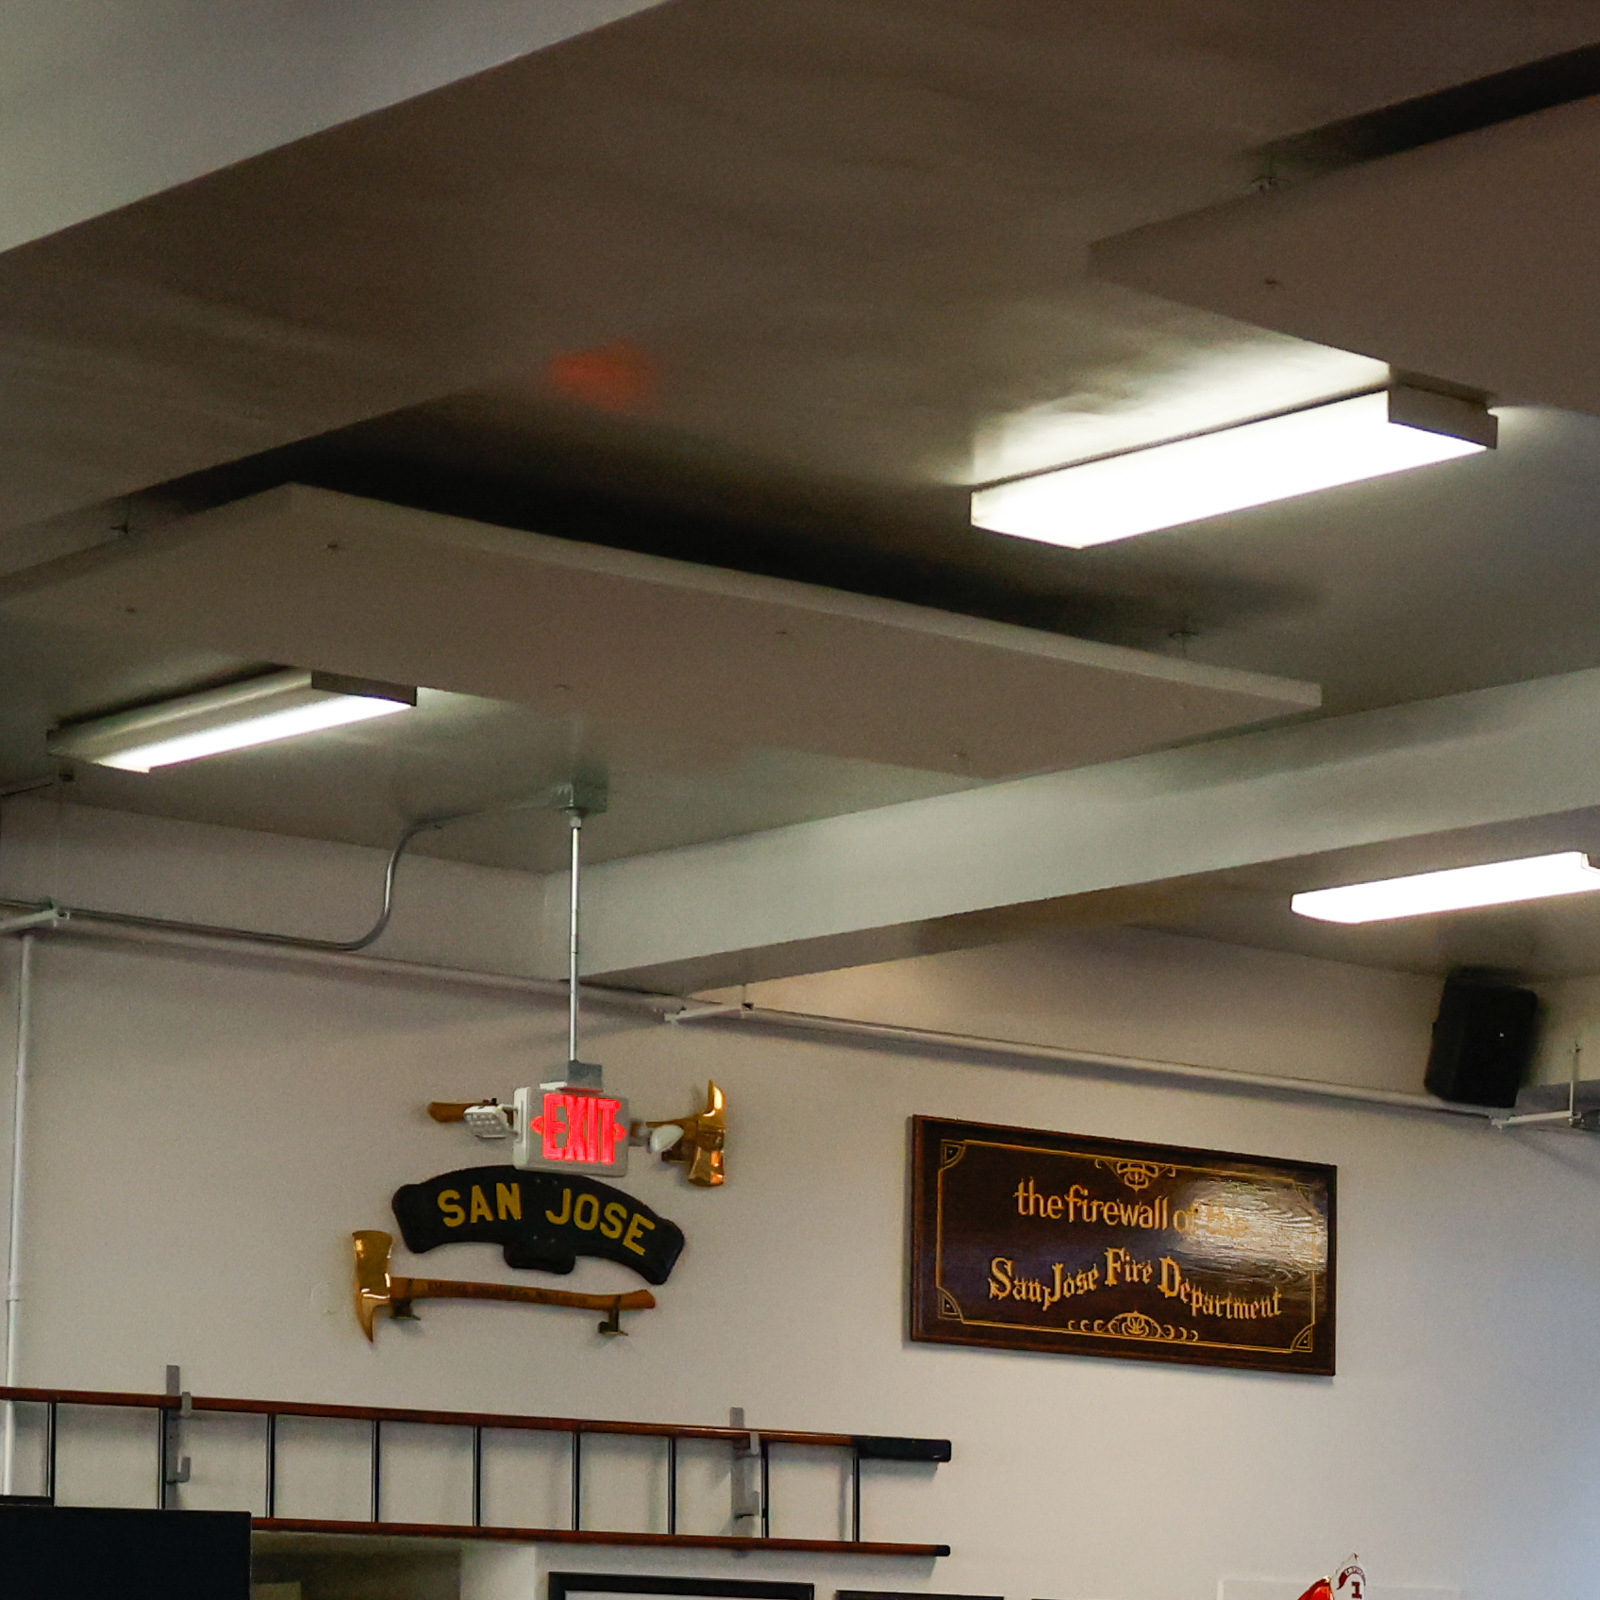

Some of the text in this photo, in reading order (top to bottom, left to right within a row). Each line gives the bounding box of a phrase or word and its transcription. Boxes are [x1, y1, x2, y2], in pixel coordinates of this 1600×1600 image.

[542, 1093, 620, 1165] EXIT
[437, 1182, 656, 1256] SAN JOSE
[1013, 1177, 1062, 1218] the
[1064, 1184, 1169, 1230] firewall
[1104, 1247, 1153, 1287] Fire
[1157, 1255, 1282, 1320] Department
[1351, 1581, 1363, 1600] 1
